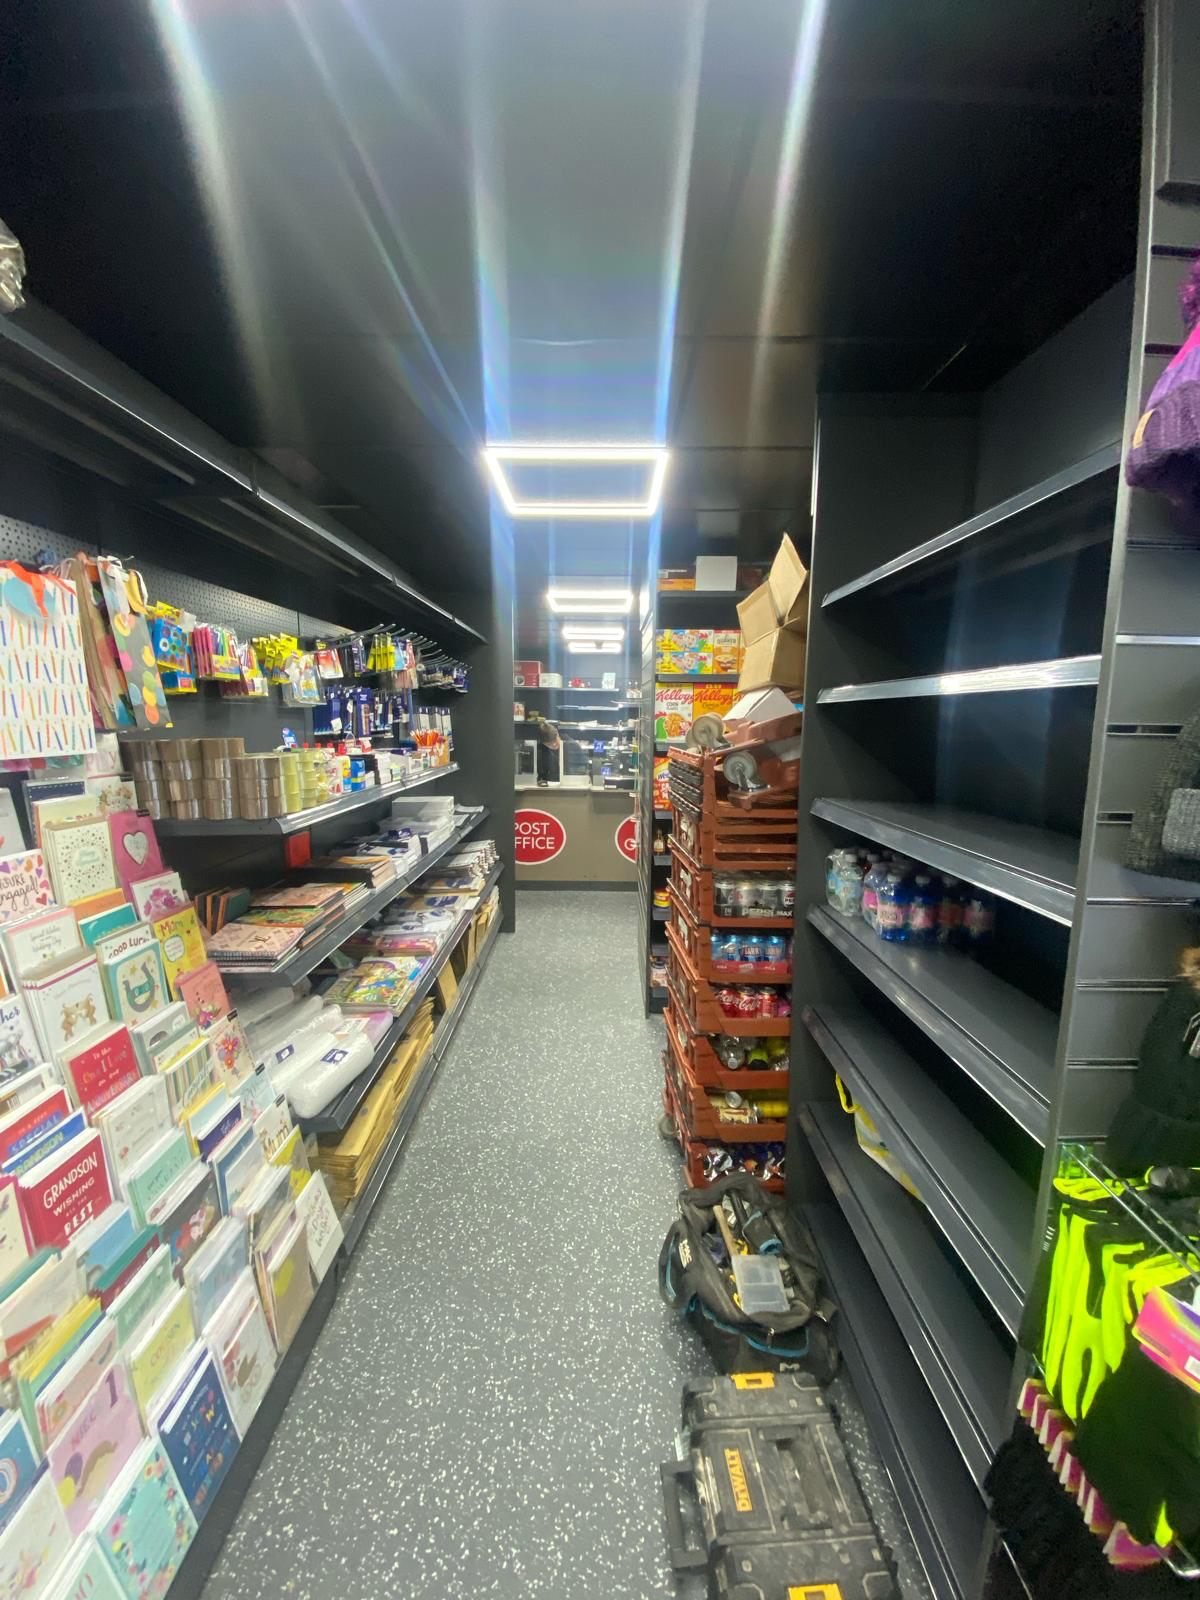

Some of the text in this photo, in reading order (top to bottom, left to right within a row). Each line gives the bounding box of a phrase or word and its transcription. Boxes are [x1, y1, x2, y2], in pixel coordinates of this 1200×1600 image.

[514, 837, 555, 850] FFICE
[43, 1151, 98, 1209] GRANDSON
[53, 1176, 95, 1217] WISHING
[64, 1199, 92, 1236] BEST
[724, 1447, 753, 1511] DEWALT
